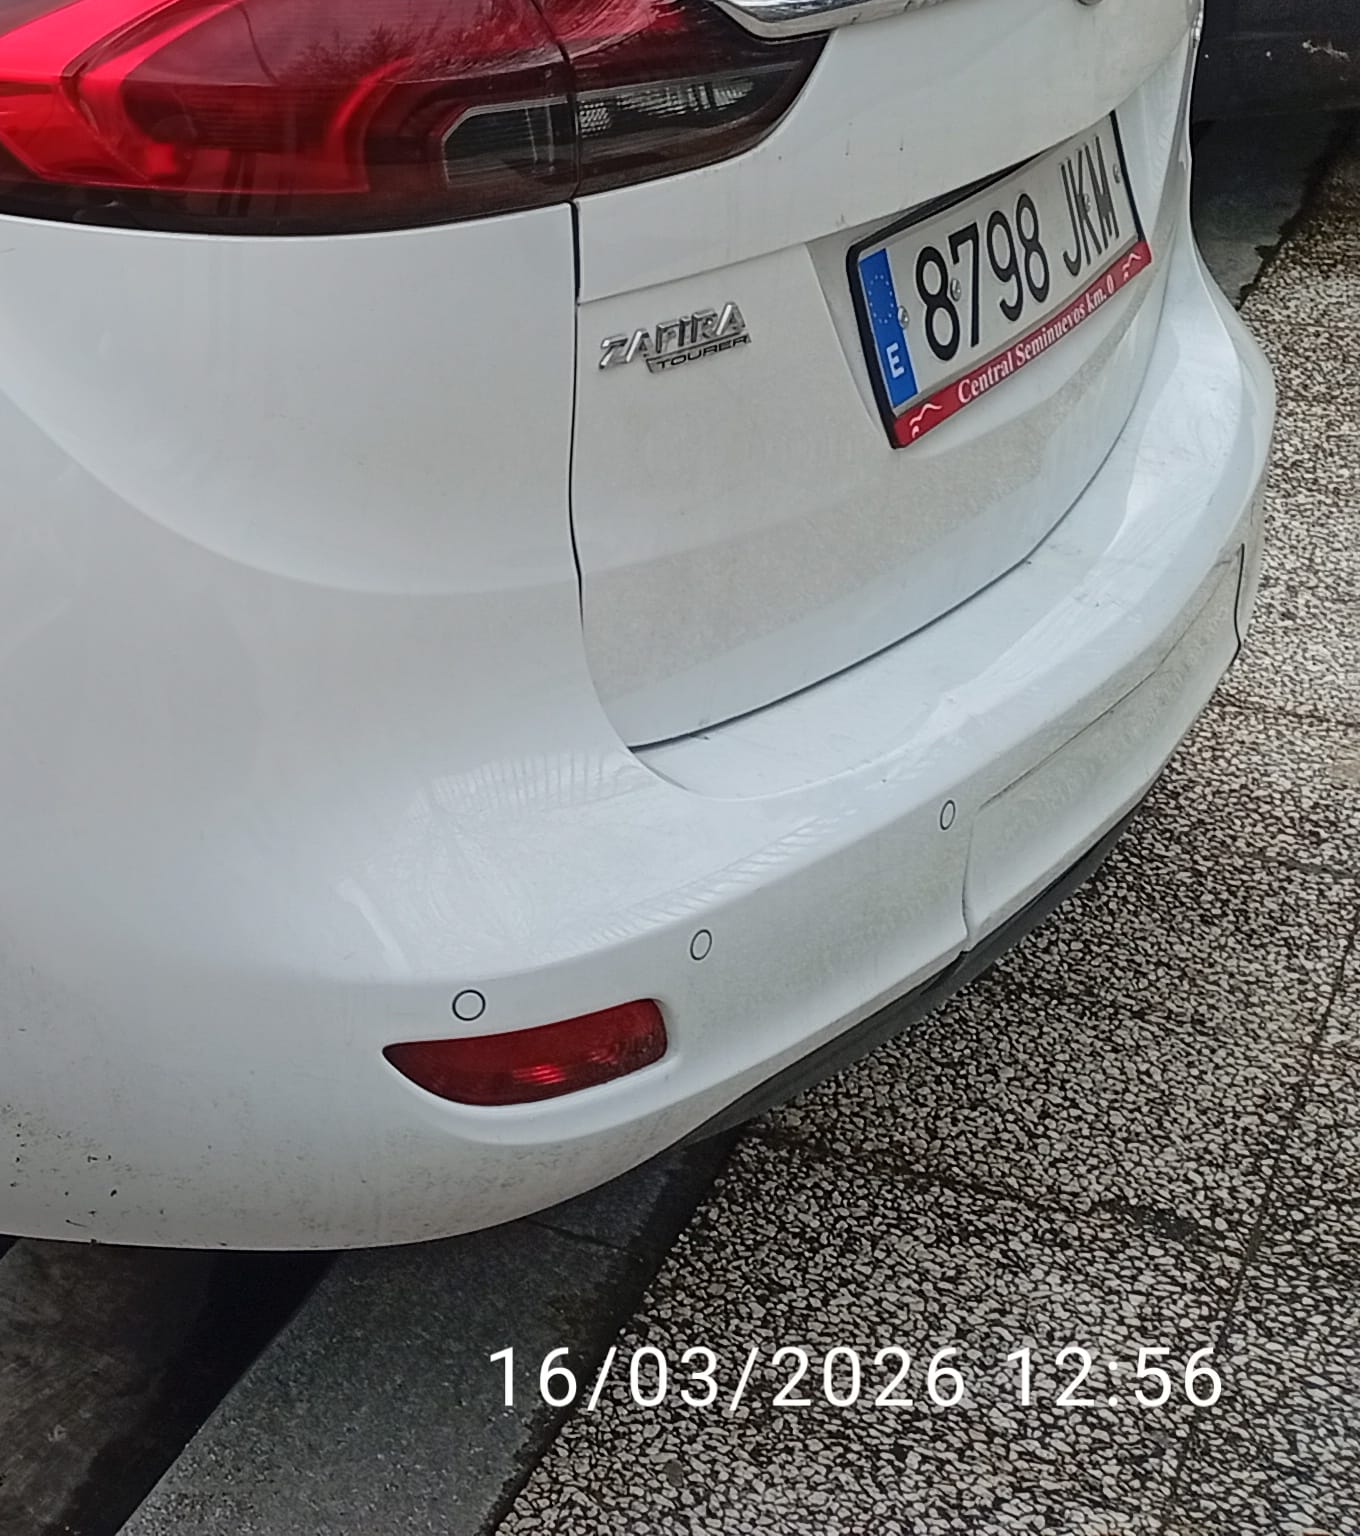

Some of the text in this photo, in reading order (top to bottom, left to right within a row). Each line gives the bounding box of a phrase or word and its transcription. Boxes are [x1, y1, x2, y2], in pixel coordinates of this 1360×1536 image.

[914, 135, 1121, 362] 8798 JKM
[598, 301, 747, 370] ZAFIRA
[656, 333, 753, 369] TOURER
[885, 341, 905, 379] E
[957, 274, 1116, 405] Central Seminuevos km. 0
